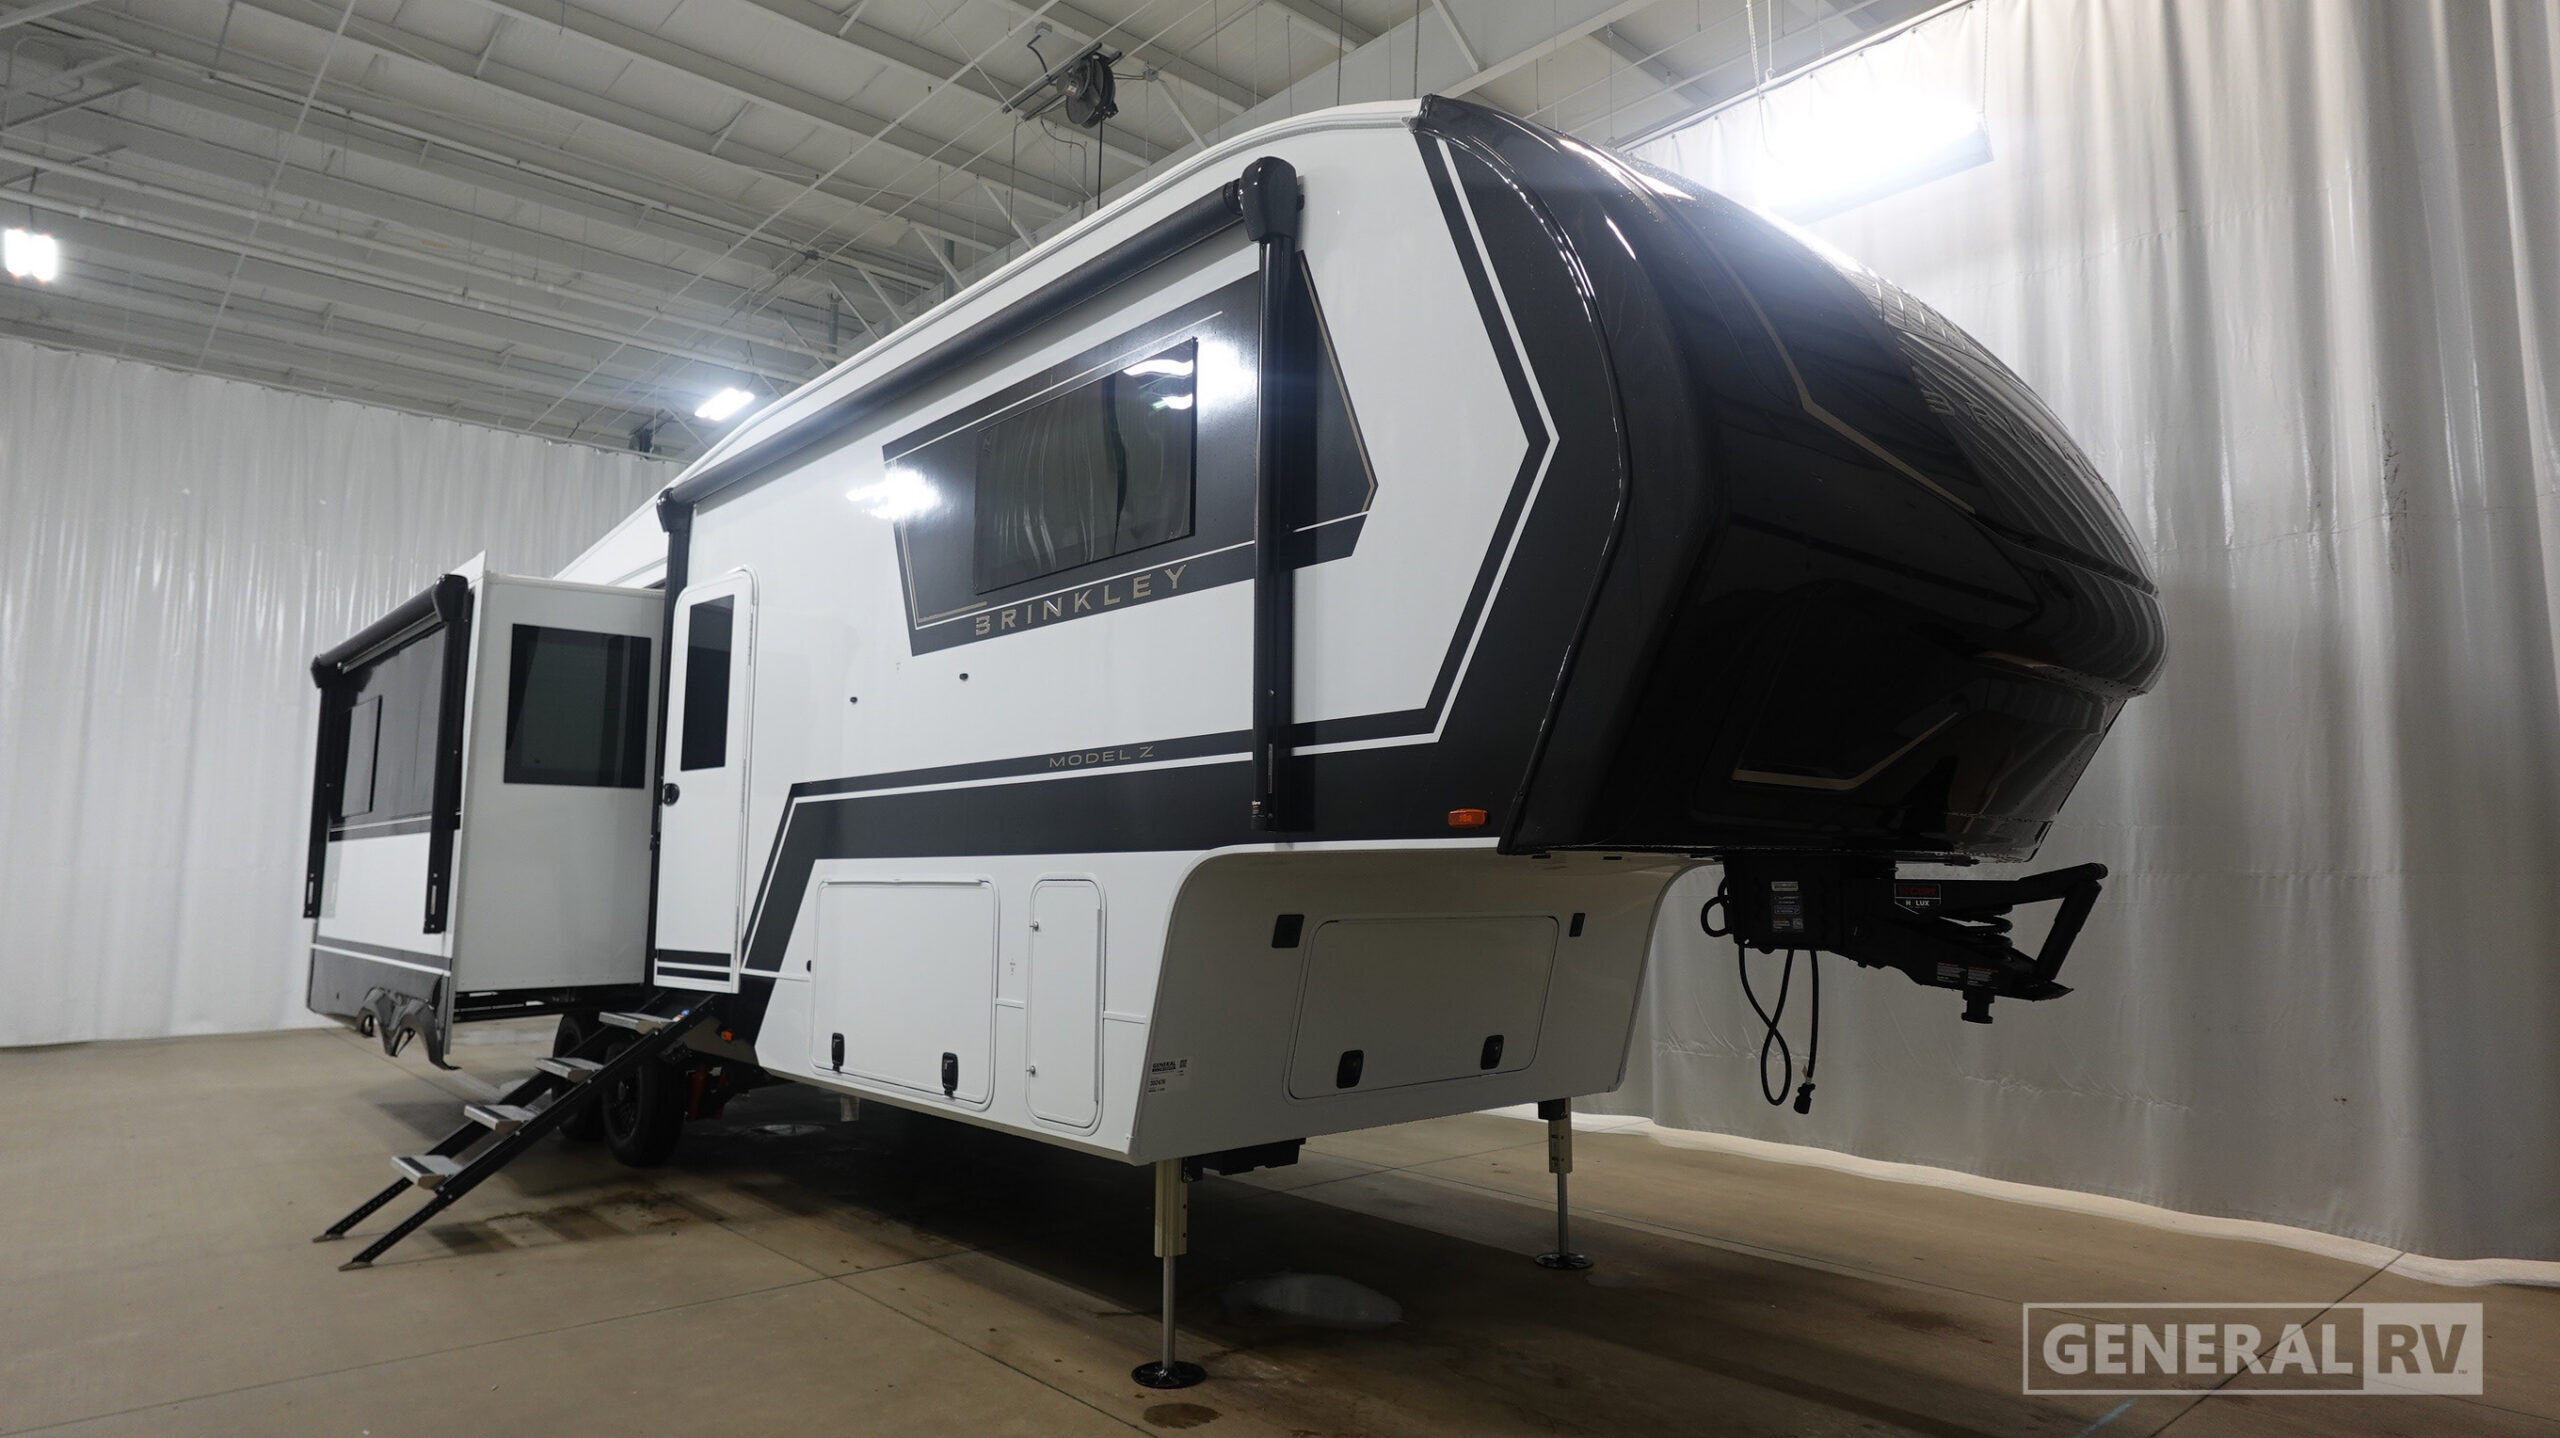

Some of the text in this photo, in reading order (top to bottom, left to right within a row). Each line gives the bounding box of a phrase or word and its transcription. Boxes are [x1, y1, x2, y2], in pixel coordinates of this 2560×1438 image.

[975, 564, 1187, 636] BRINKLEY
[1049, 745, 1154, 768] MODEL Z
